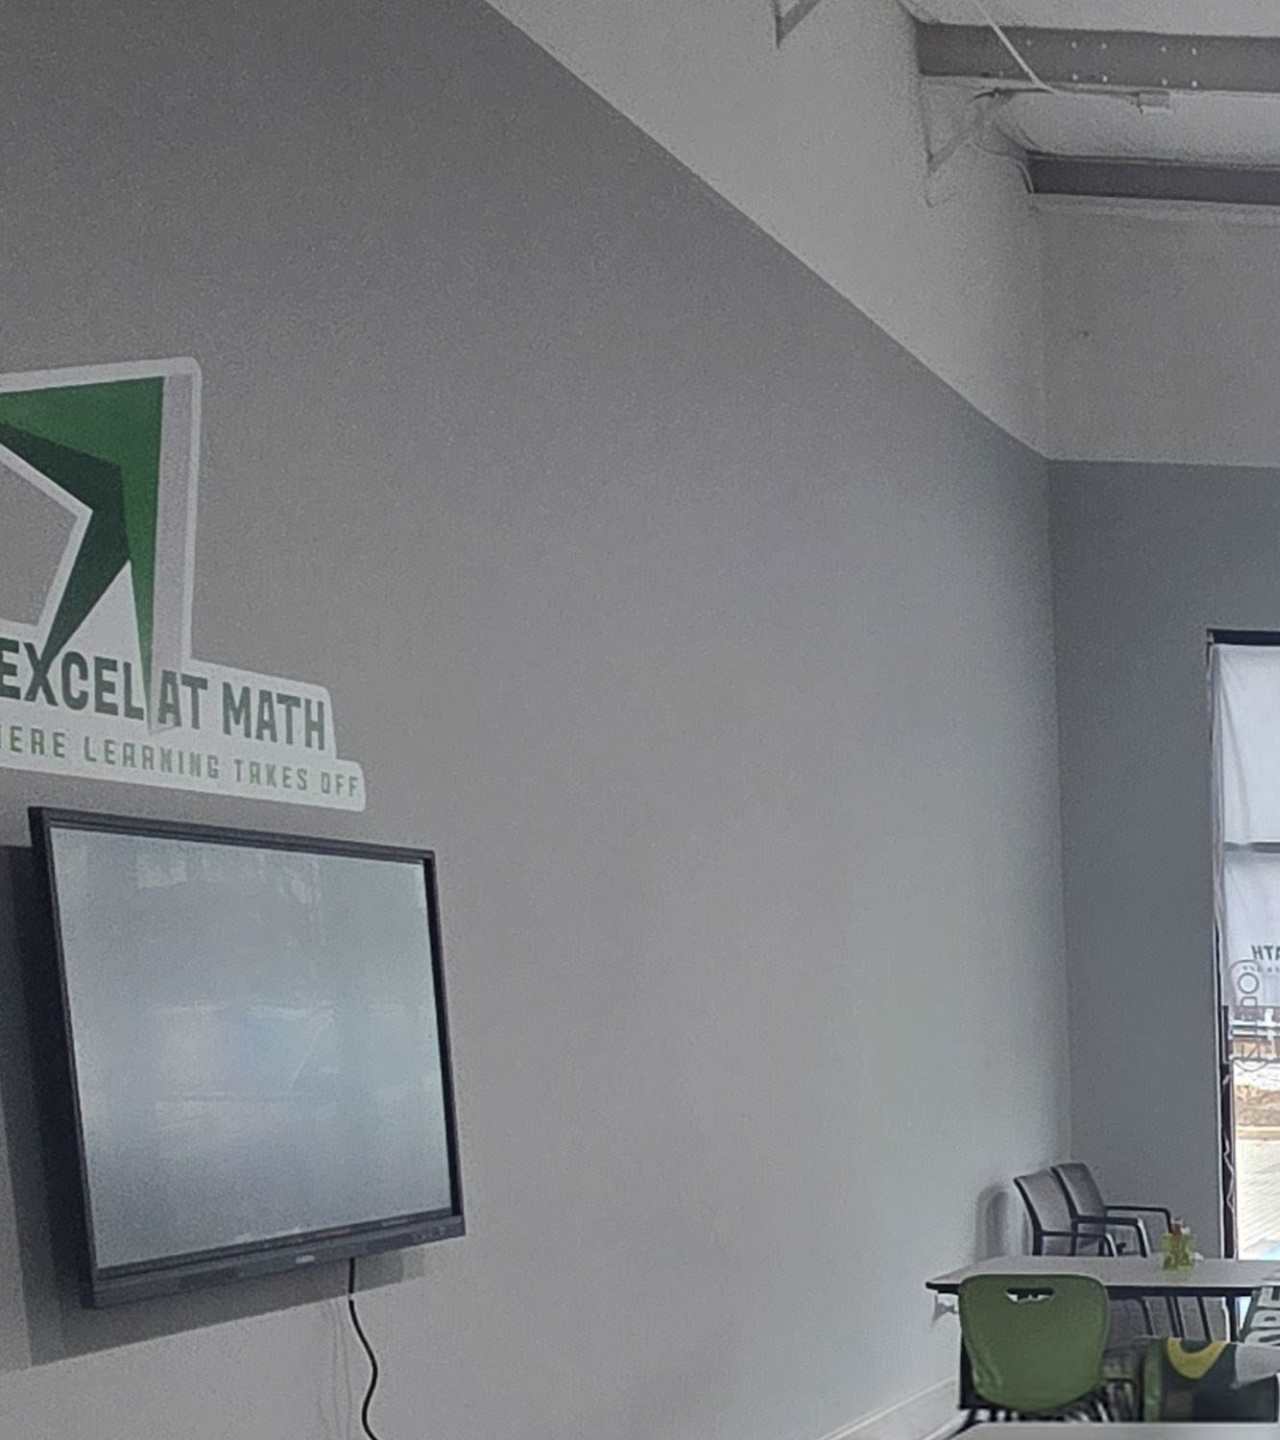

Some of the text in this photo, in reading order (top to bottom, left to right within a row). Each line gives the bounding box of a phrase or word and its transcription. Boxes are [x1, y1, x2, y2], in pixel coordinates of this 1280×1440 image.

[0, 637, 325, 751] EXCEL AT MATH
[0, 724, 358, 797] ERE LEARNING TAKES OFF
